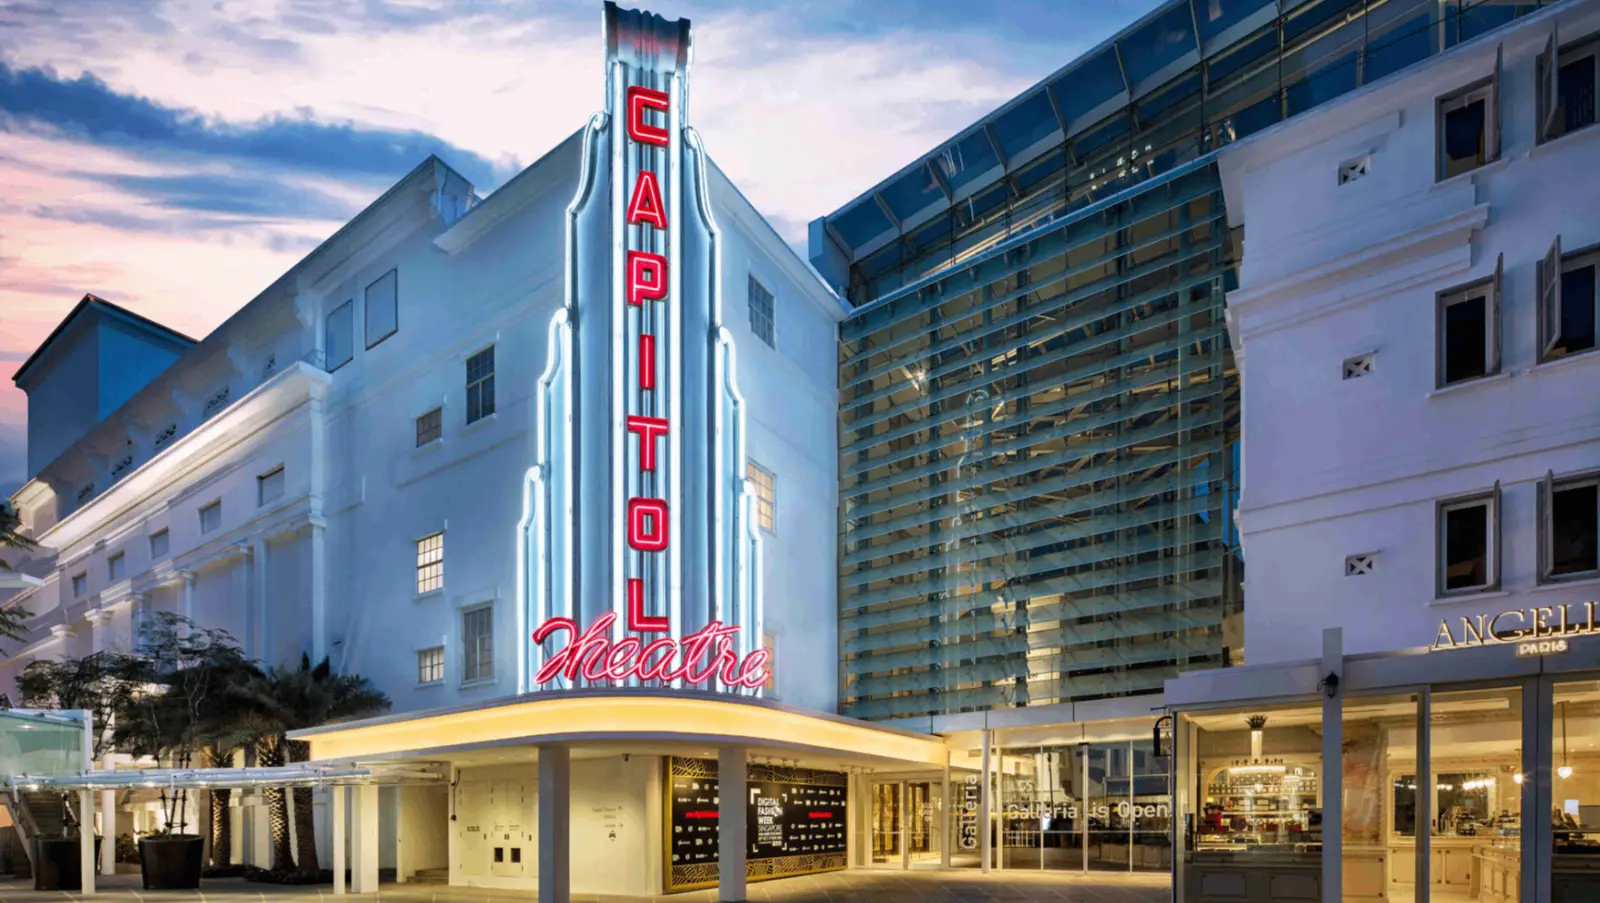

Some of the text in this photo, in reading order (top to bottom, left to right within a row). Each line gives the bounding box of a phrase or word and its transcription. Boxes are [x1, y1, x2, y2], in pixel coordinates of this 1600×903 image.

[626, 85, 669, 632] CAPITOL
[532, 611, 772, 688] Theatre
[1519, 640, 1567, 655] PARIS
[758, 797, 779, 806] DIGITAL
[962, 774, 977, 849] Galleria
[1007, 802, 1078, 819] Galleria
[758, 816, 773, 825] WEEK
